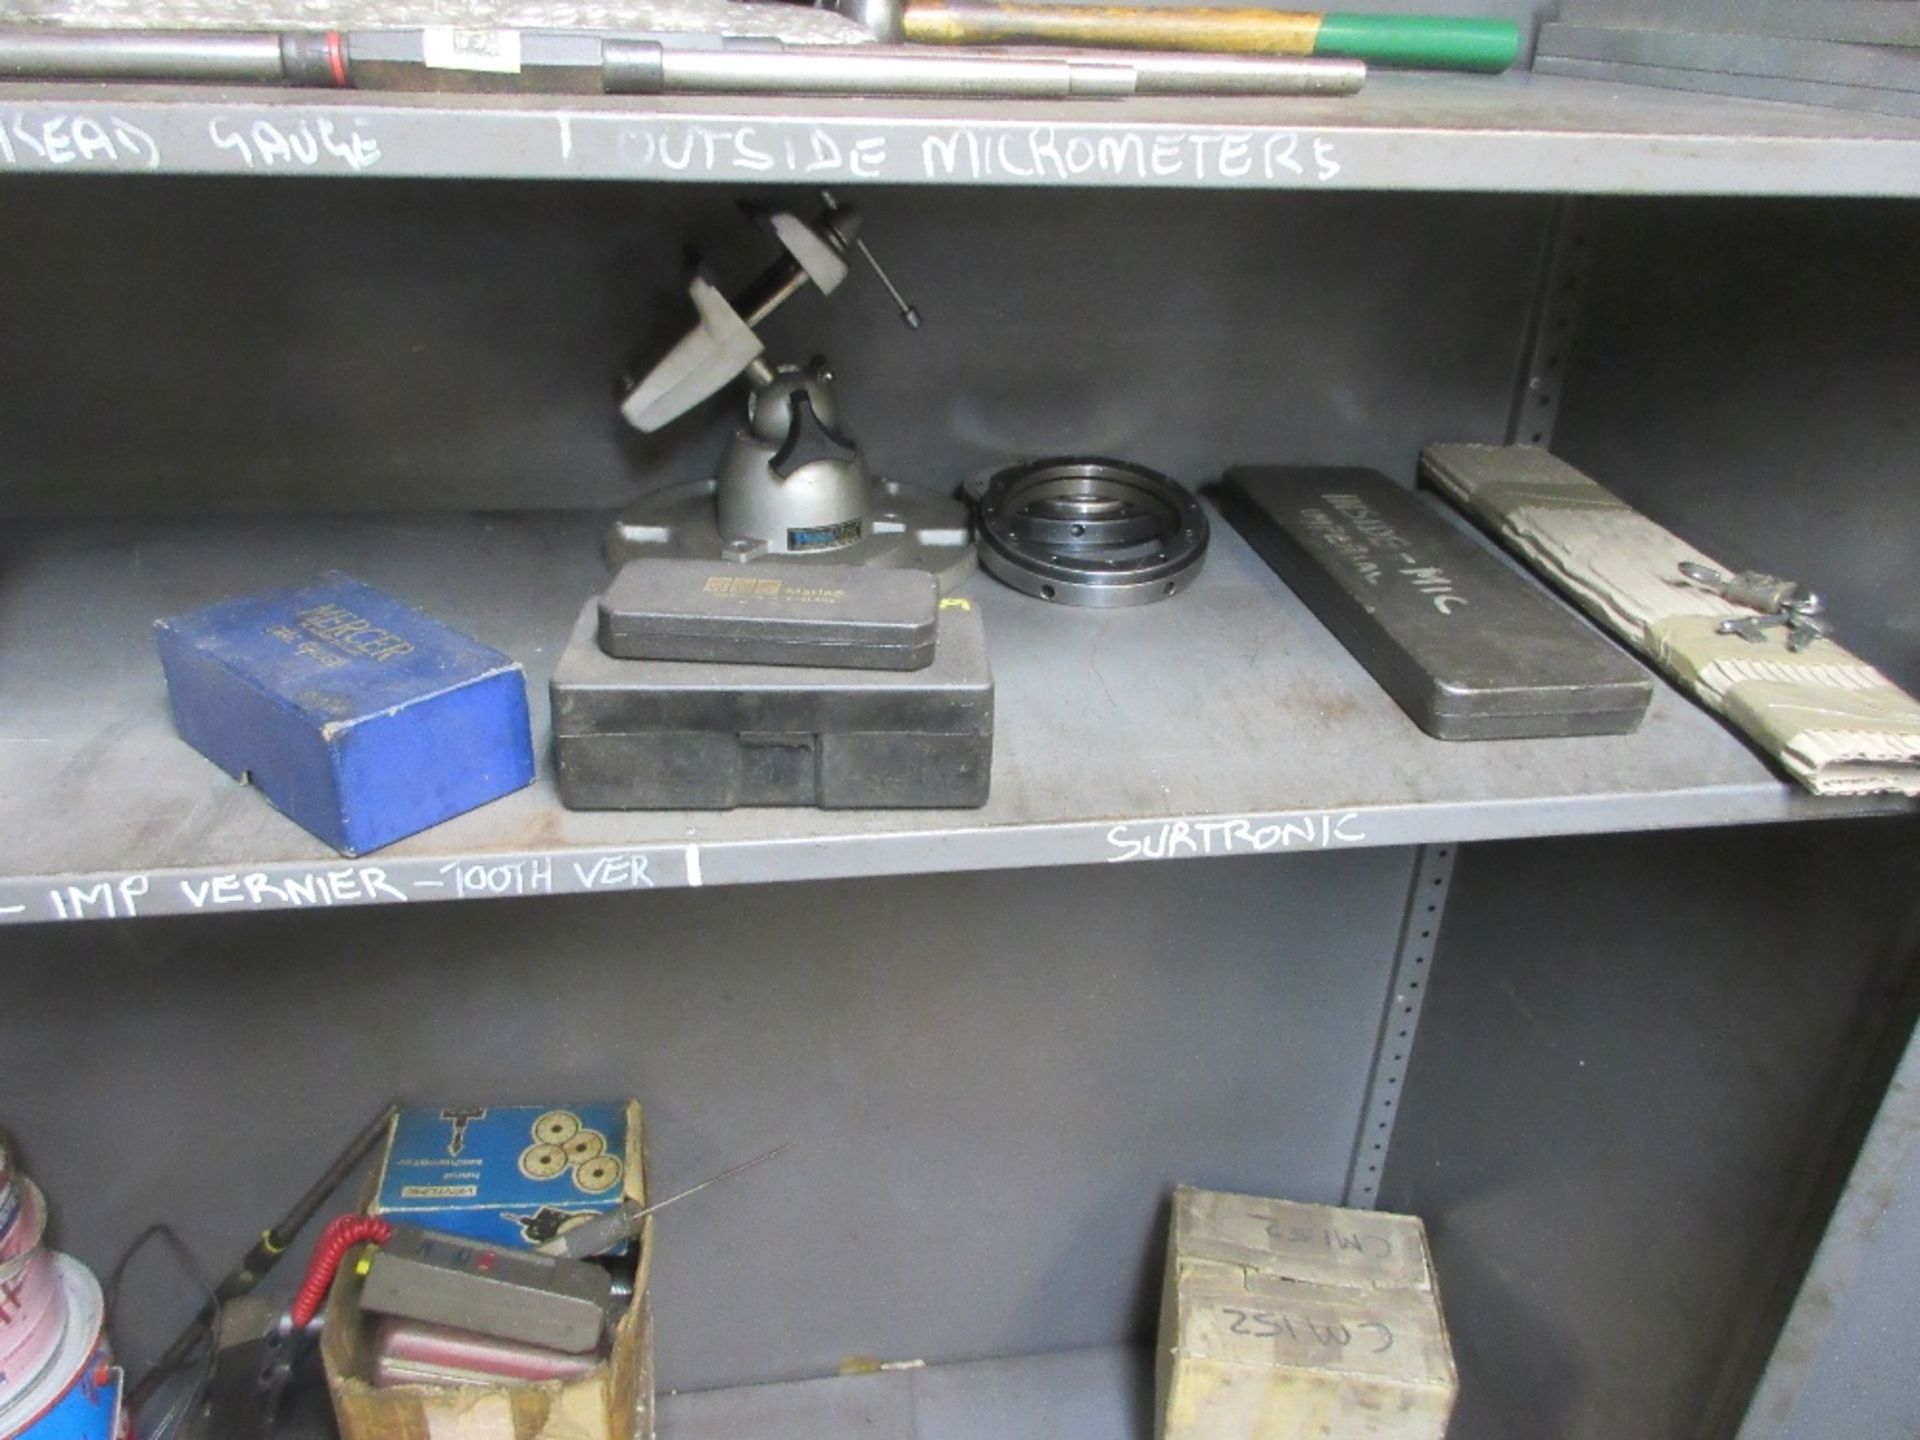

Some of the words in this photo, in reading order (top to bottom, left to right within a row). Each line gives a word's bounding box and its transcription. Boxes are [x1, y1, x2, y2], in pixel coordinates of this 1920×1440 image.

[208, 115, 382, 171] GAUGE
[617, 126, 887, 178] OUTSIDE
[921, 126, 1342, 181] MICROMETERS
[1106, 813, 1366, 863] SURTRONIC
[50, 874, 149, 918] IMP
[180, 867, 407, 908] VERNIER
[573, 855, 654, 888] VER
[1222, 1308, 1394, 1353] CM152
